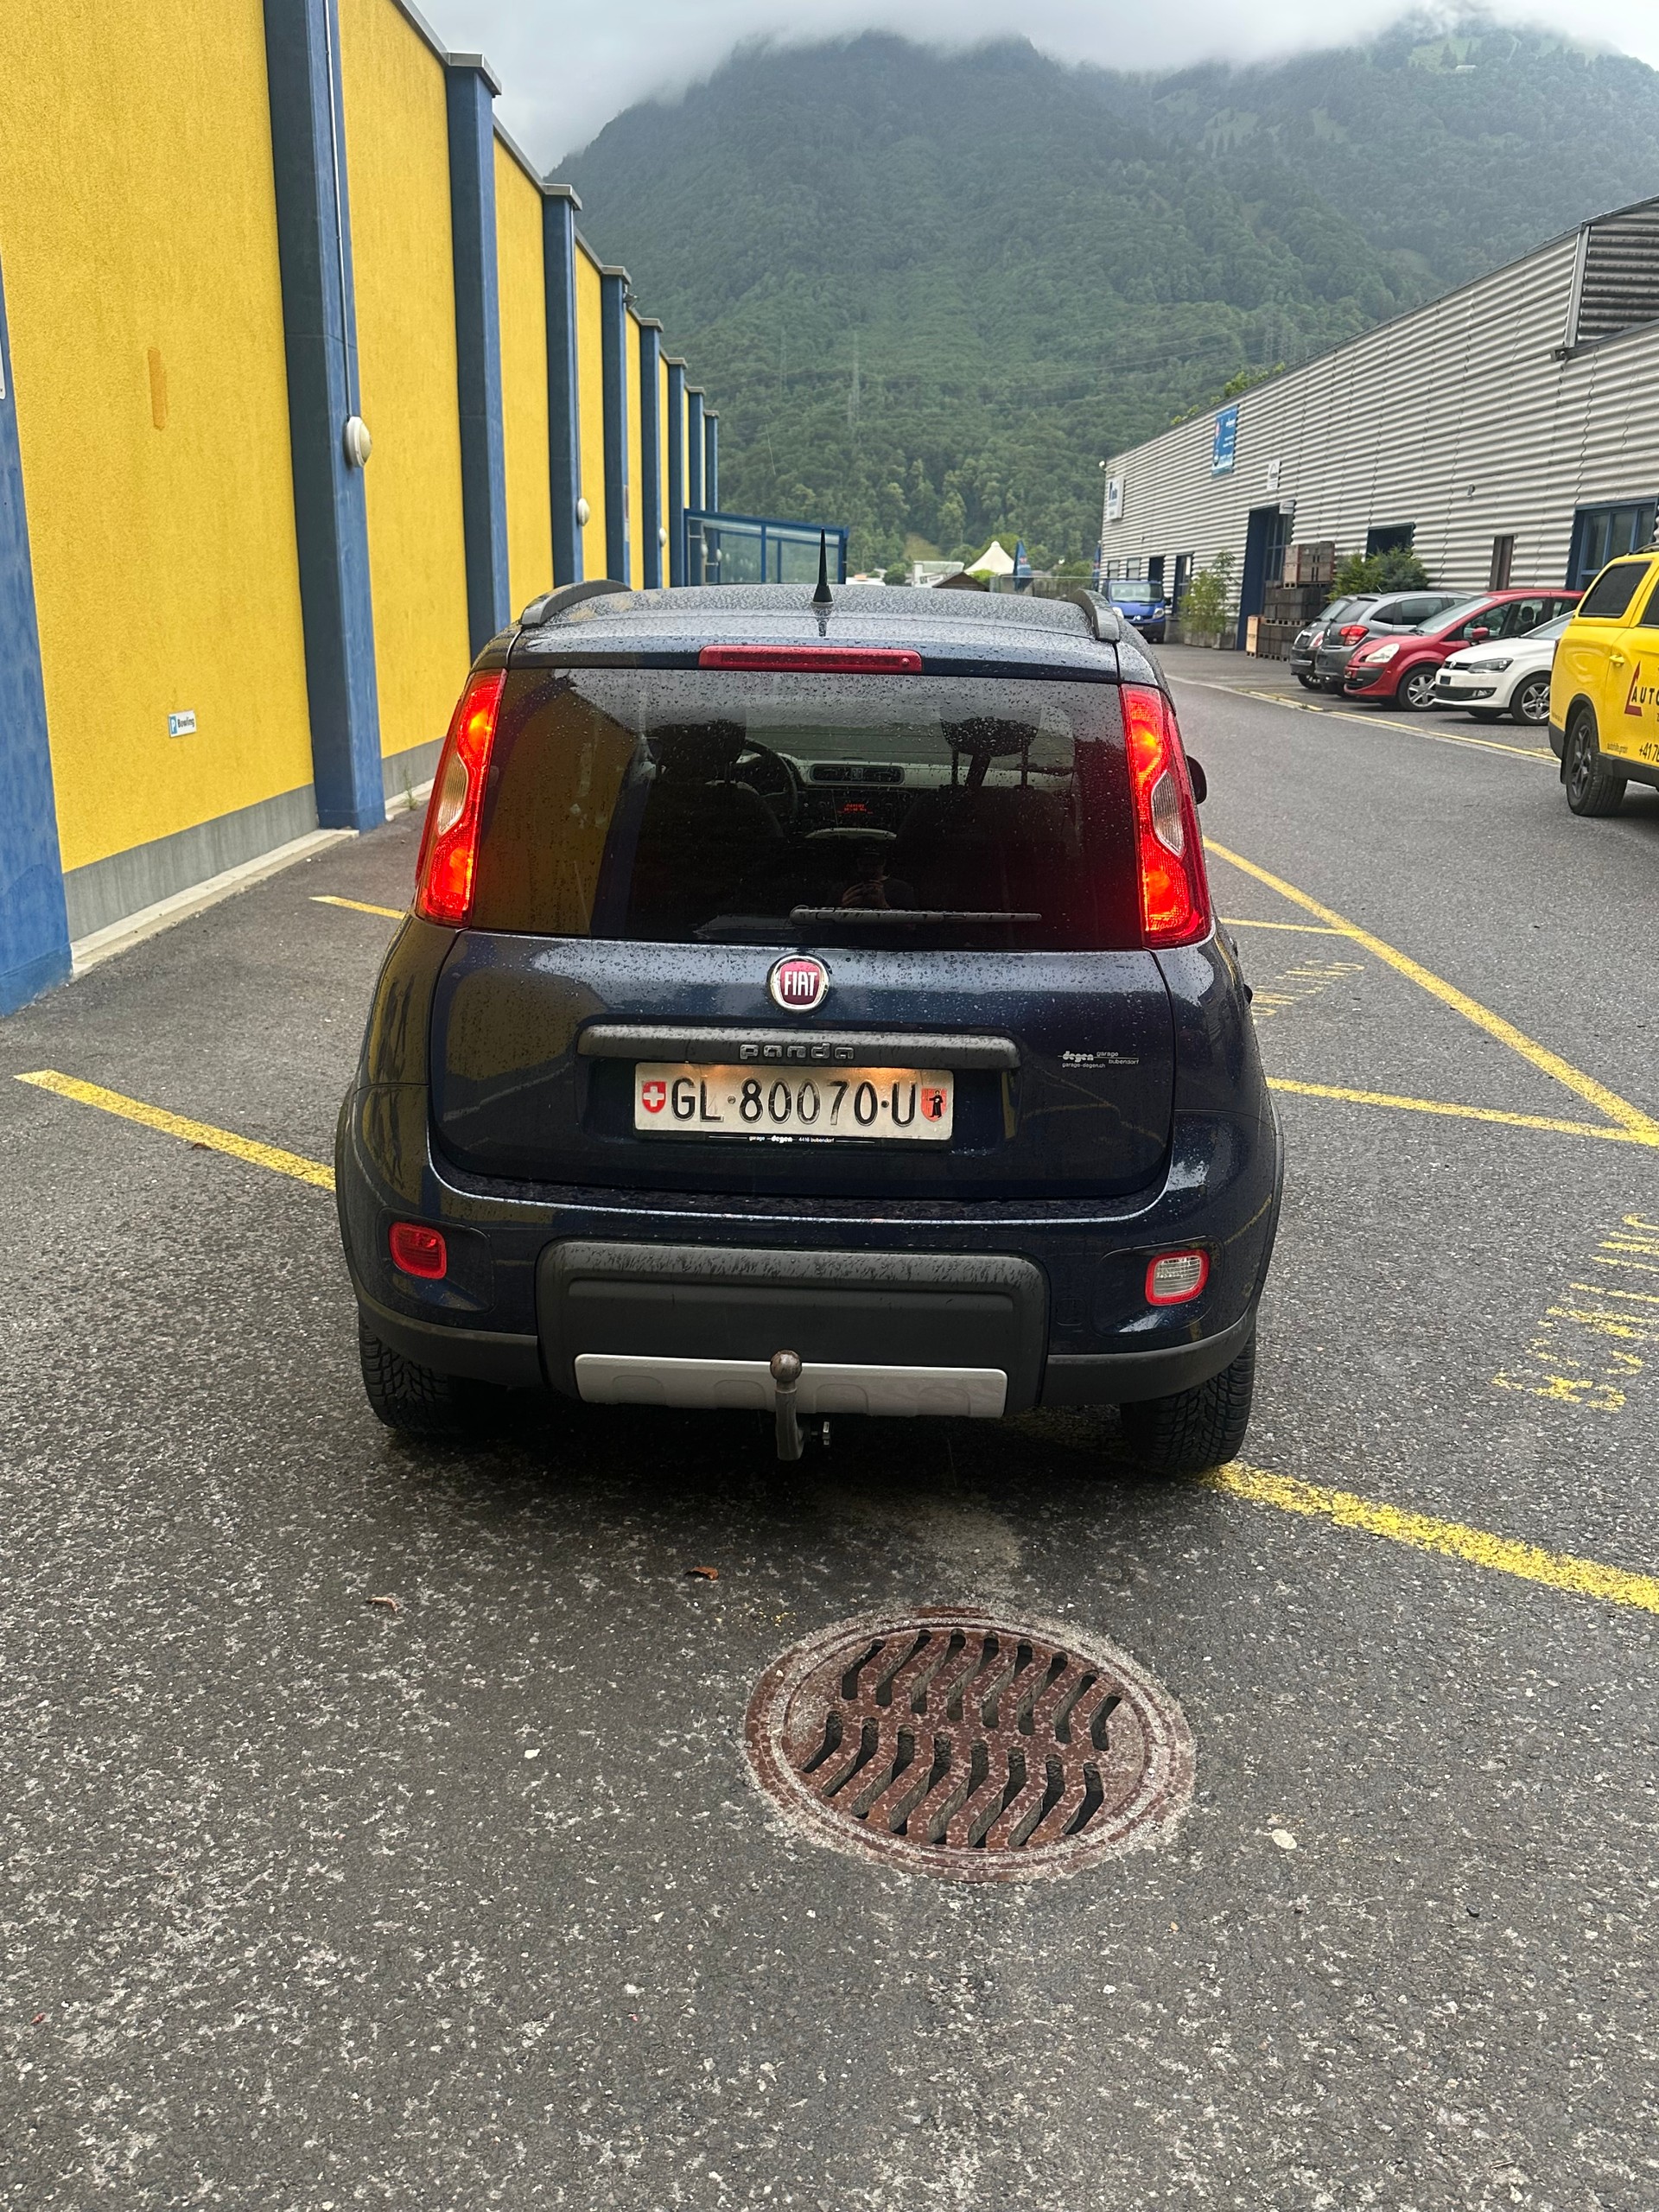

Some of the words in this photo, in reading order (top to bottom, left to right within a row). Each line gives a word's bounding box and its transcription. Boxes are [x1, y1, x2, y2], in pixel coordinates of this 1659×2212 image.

[784, 971, 817, 997] FIAT
[739, 1042, 855, 1060] panda
[1062, 1051, 1094, 1063] degen
[771, 1134, 793, 1144] degen
